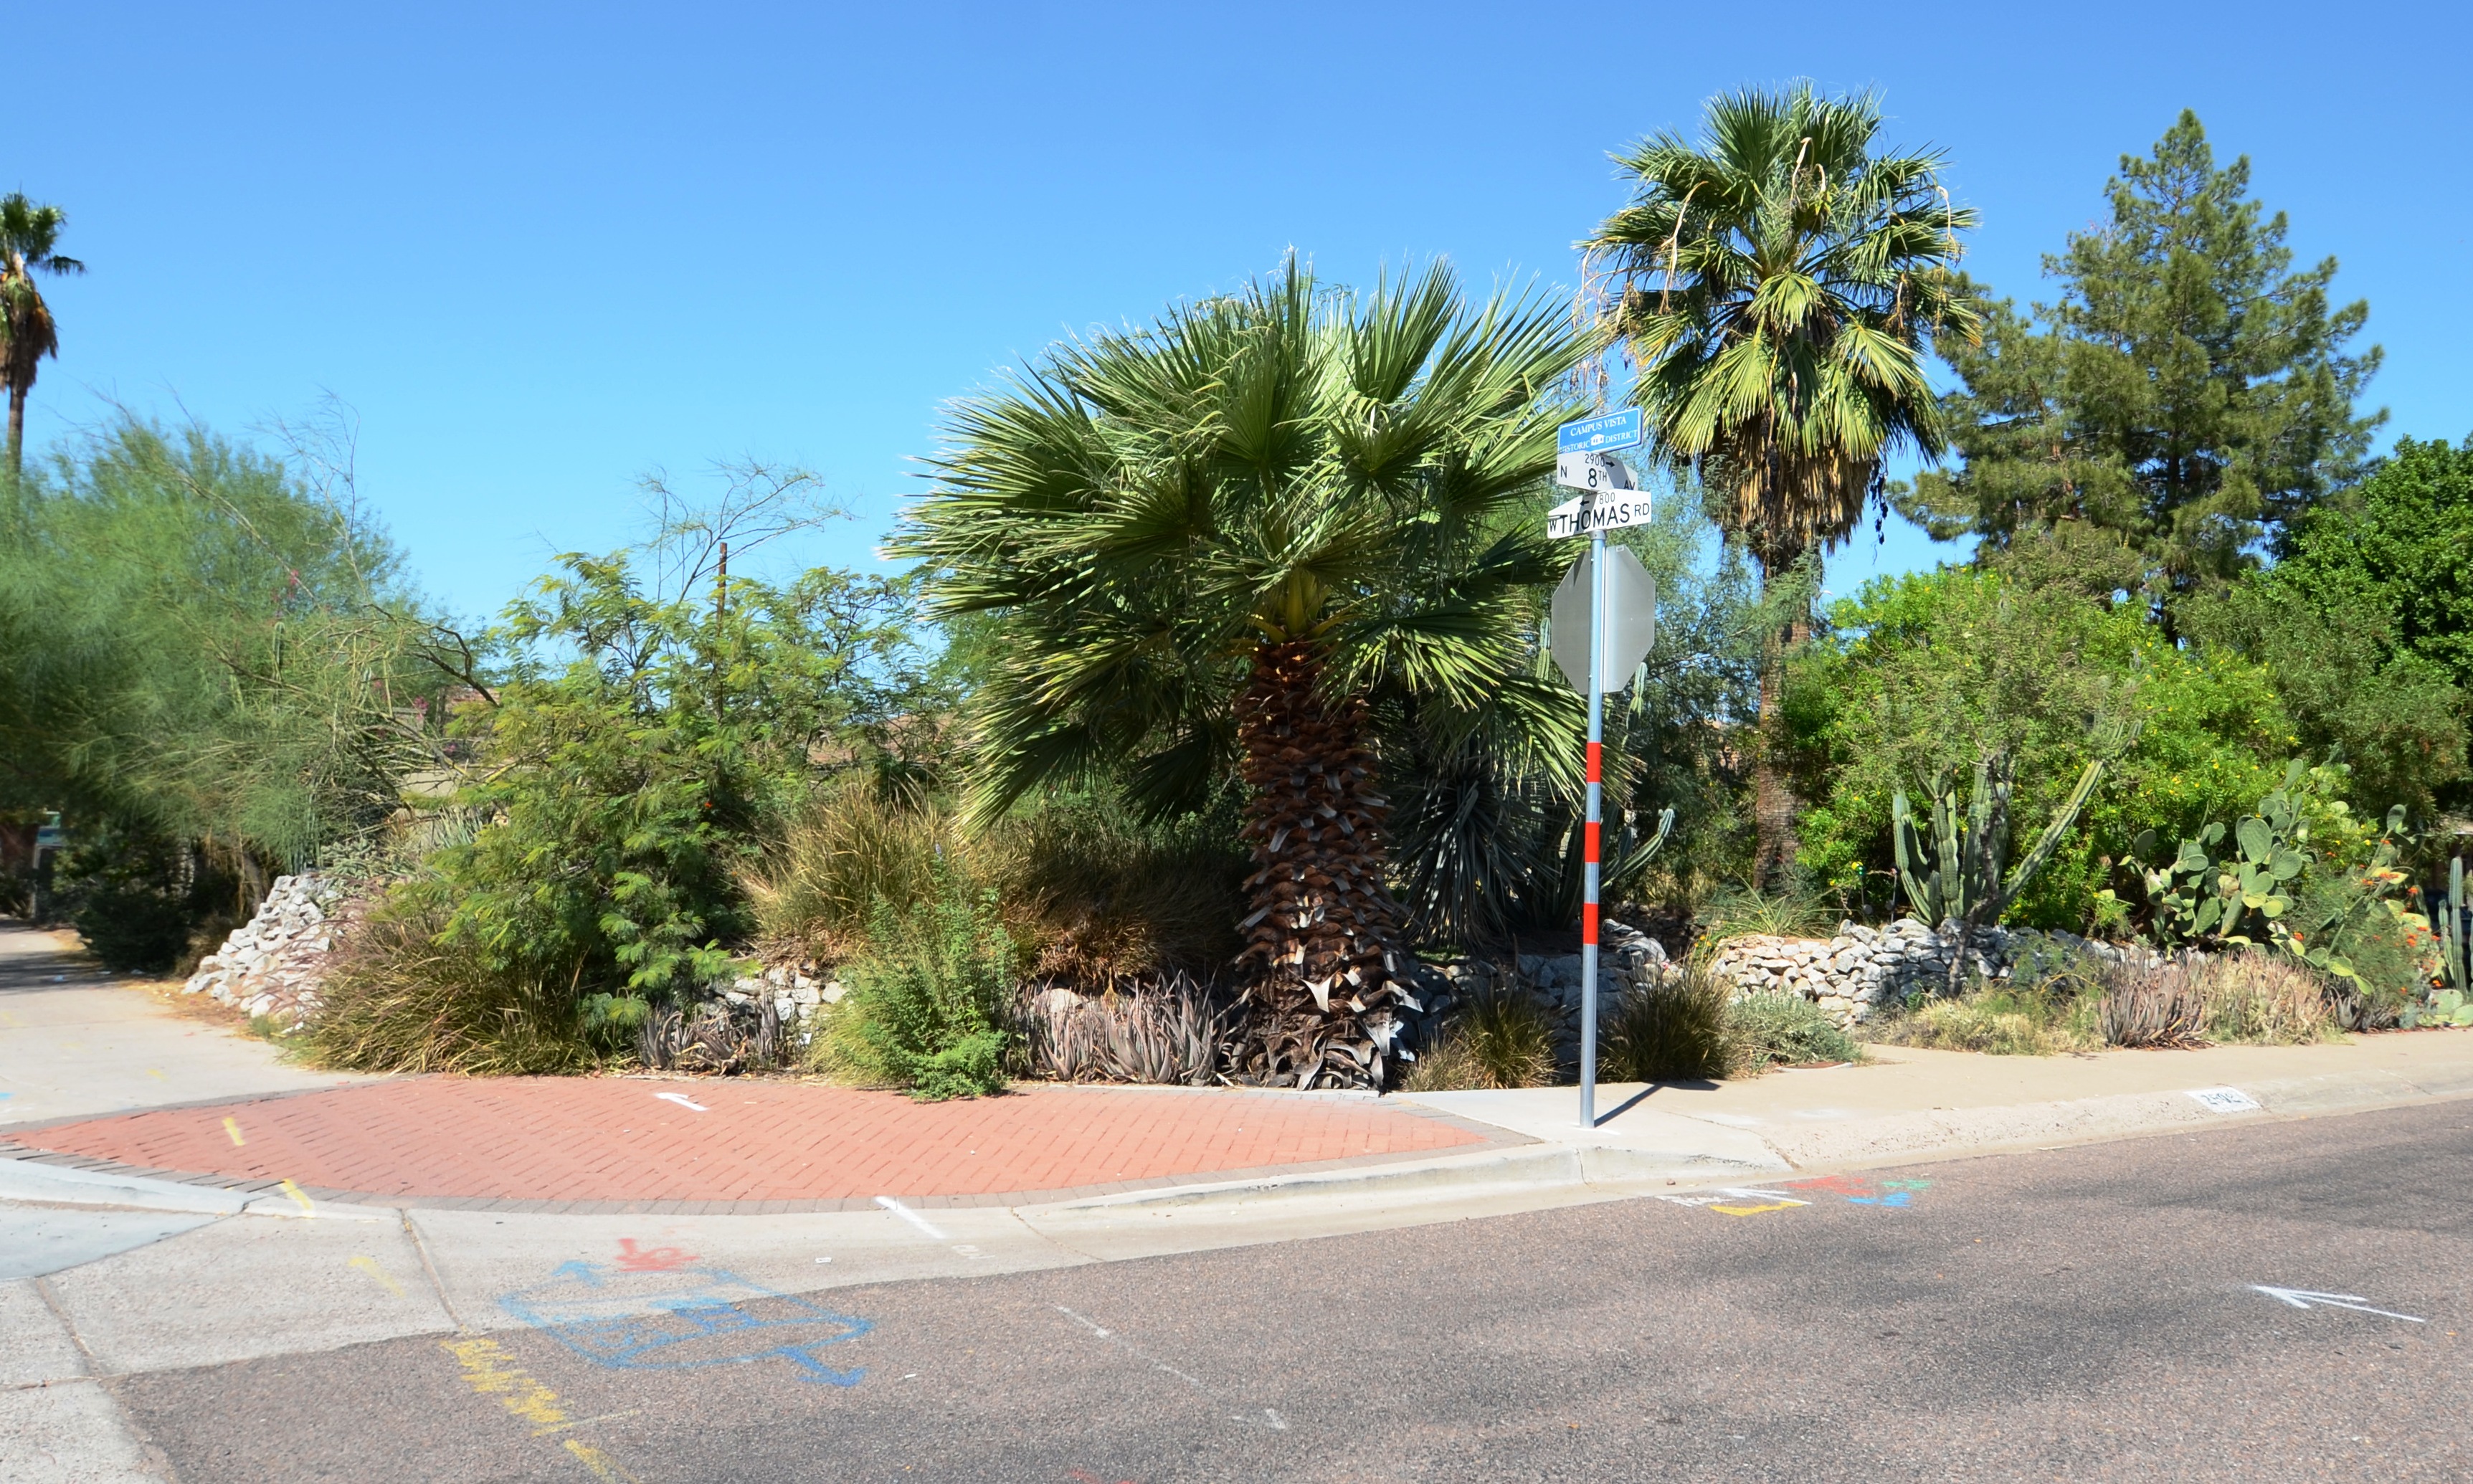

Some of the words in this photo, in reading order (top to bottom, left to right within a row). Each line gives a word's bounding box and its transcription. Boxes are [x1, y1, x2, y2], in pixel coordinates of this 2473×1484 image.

[1570, 421, 1602, 436] CAMPUS
[1605, 417, 1627, 429] VISTA
[1605, 429, 1638, 443] DISTRICT
[1585, 454, 1605, 467] 2900
[1560, 465, 1567, 478] N
[1587, 467, 1608, 488] 8TH
[1599, 493, 1615, 504] 800
[1549, 519, 1557, 532] W
[1560, 503, 1630, 533] THOMAS
[1634, 503, 1650, 517] RD
